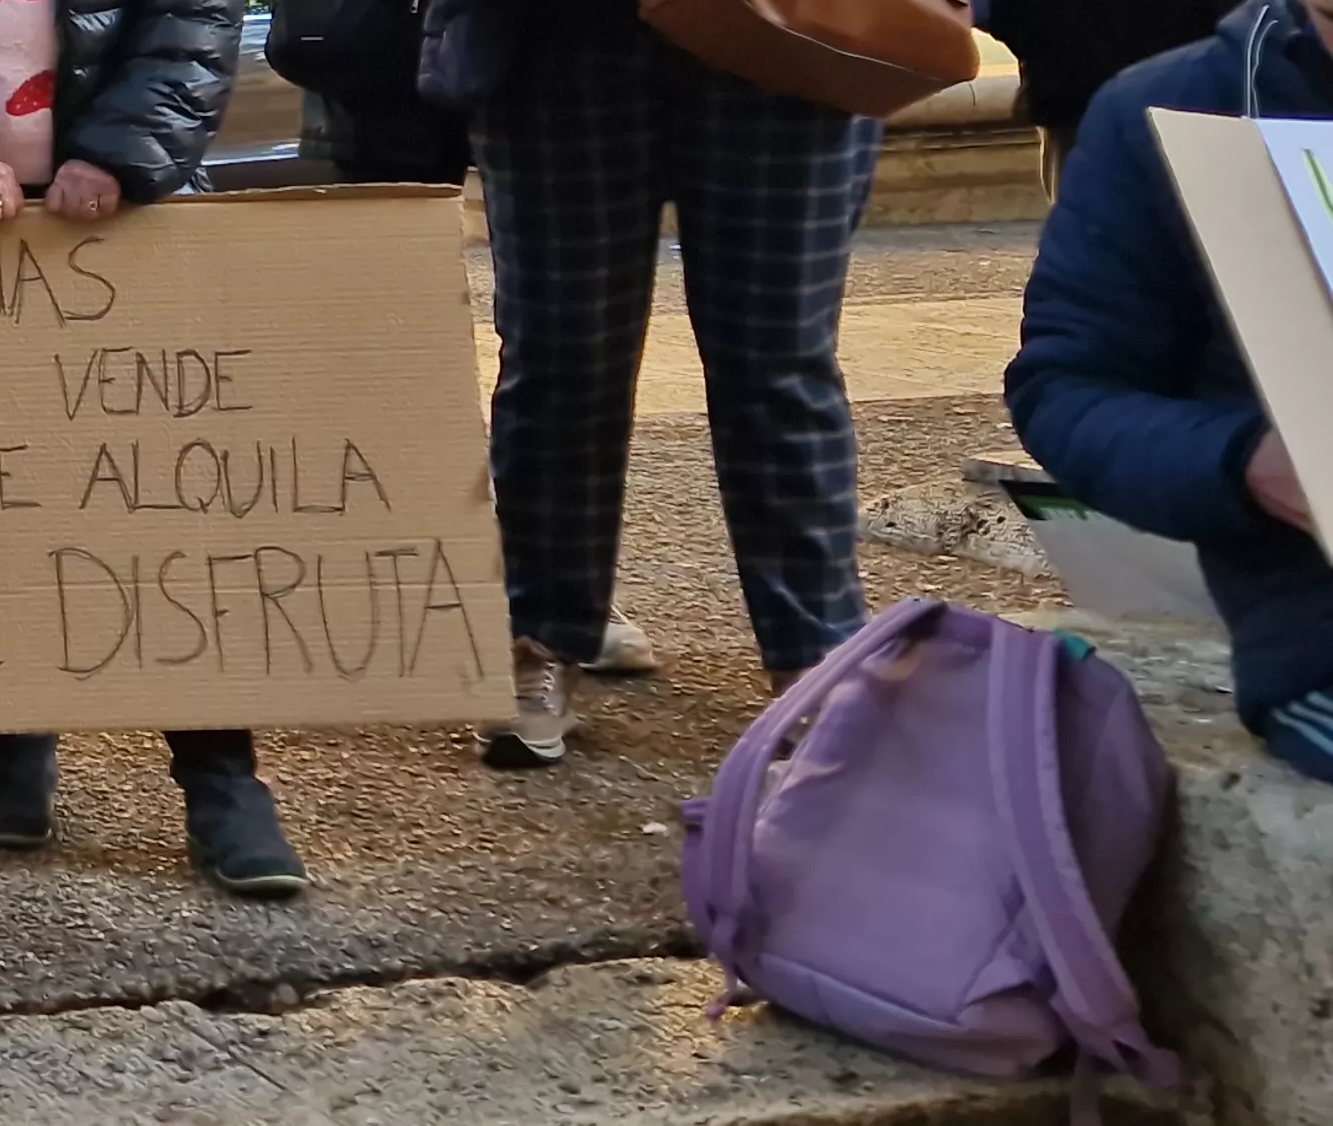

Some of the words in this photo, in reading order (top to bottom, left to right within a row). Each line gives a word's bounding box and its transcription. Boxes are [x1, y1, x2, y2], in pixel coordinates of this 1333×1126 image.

[53, 346, 254, 422] VENDE
[79, 436, 393, 519] ALQUILA
[47, 537, 486, 682] DISFRUTA
